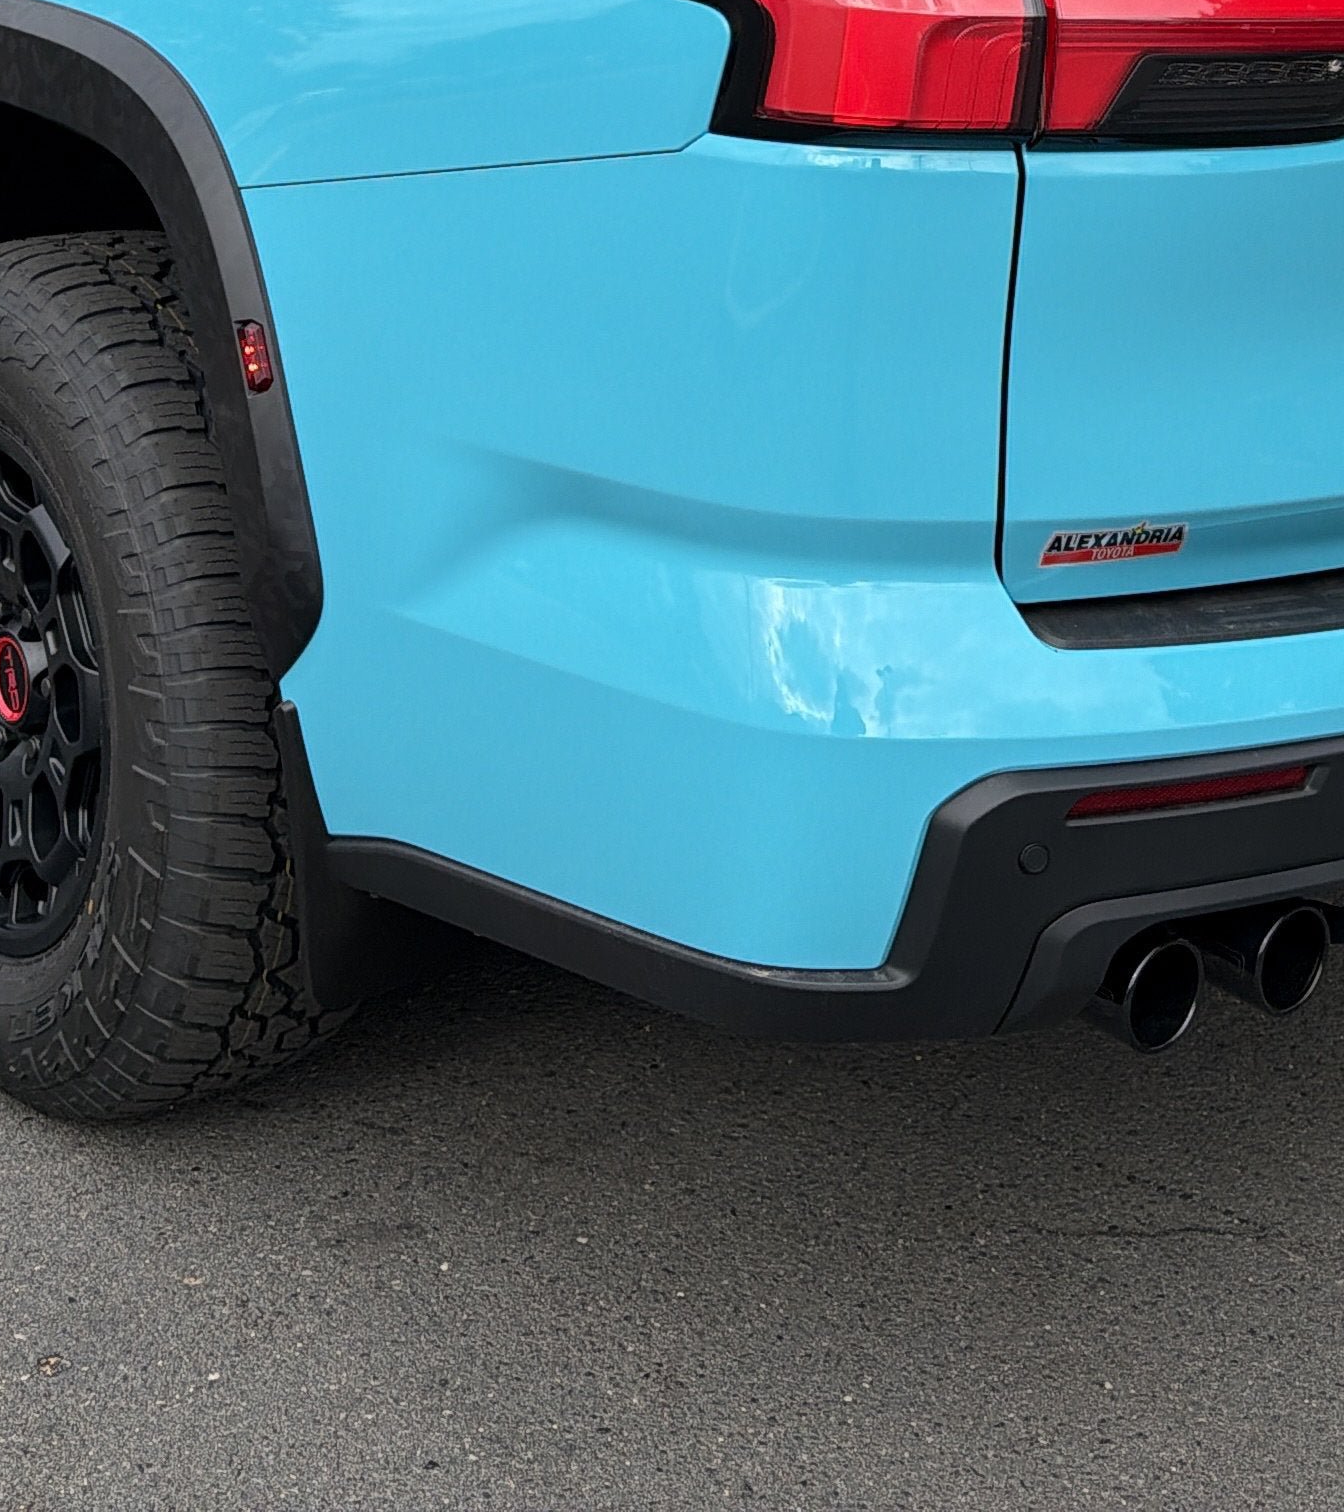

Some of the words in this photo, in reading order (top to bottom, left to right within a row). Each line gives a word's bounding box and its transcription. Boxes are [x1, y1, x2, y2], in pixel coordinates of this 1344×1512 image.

[1046, 525, 1186, 554] ALEXANDRIA
[1090, 545, 1136, 561] TOYOTA
[3, 645, 20, 711] TRD
